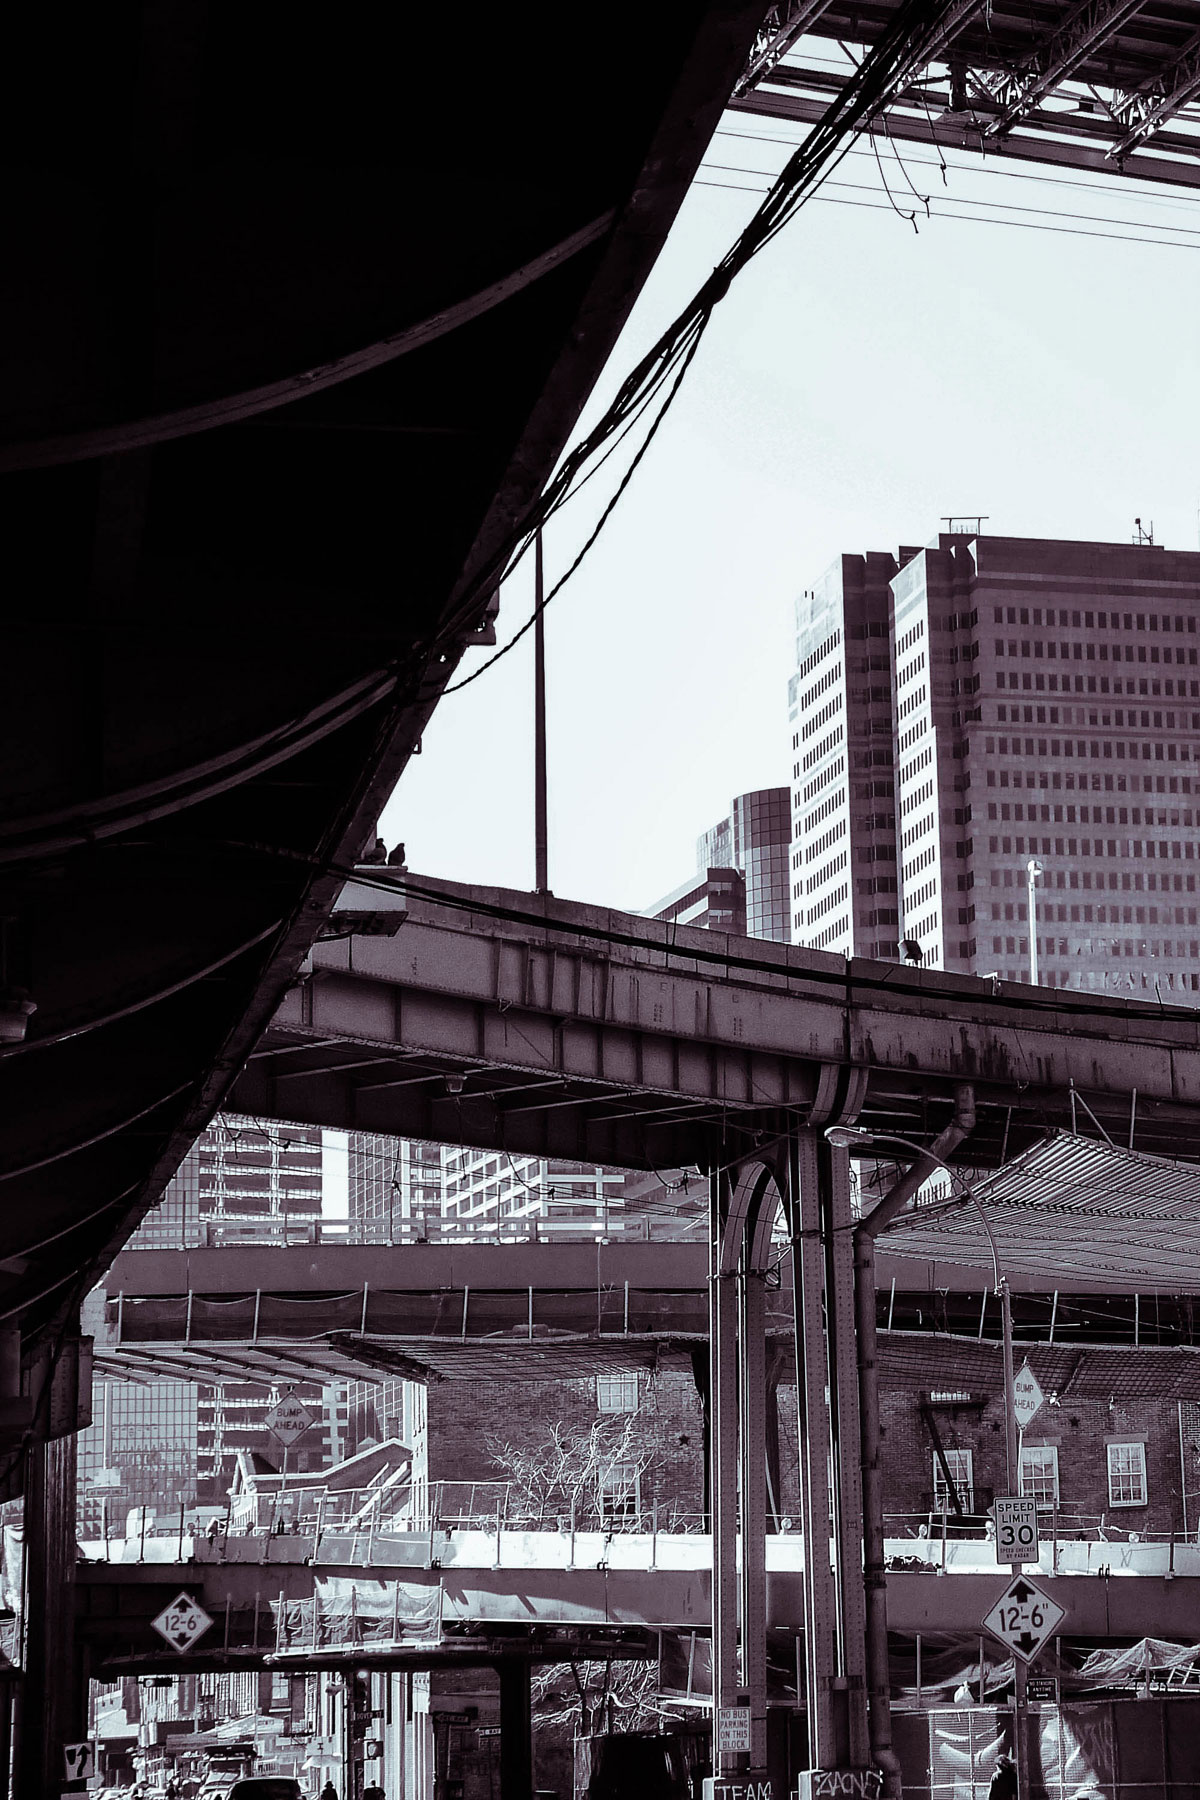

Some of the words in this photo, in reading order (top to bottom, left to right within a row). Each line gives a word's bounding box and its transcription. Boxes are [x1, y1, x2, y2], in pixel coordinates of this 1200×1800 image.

[1015, 1382, 1034, 1393] BUMP
[1014, 1398, 1036, 1411] AHEAD
[276, 1407, 303, 1417] BUMP
[273, 1420, 305, 1430] AHEAD
[997, 1502, 1034, 1512] SPEED
[1001, 1513, 1030, 1523] LIMIT
[1000, 1525, 1034, 1545] 30
[720, 1710, 731, 1719] NO
[732, 1710, 748, 1719] BUS
[719, 1719, 748, 1729] PARKING
[720, 1730, 731, 1739] ON
[732, 1730, 748, 1739] THIS
[722, 1740, 746, 1749] BLOCK
